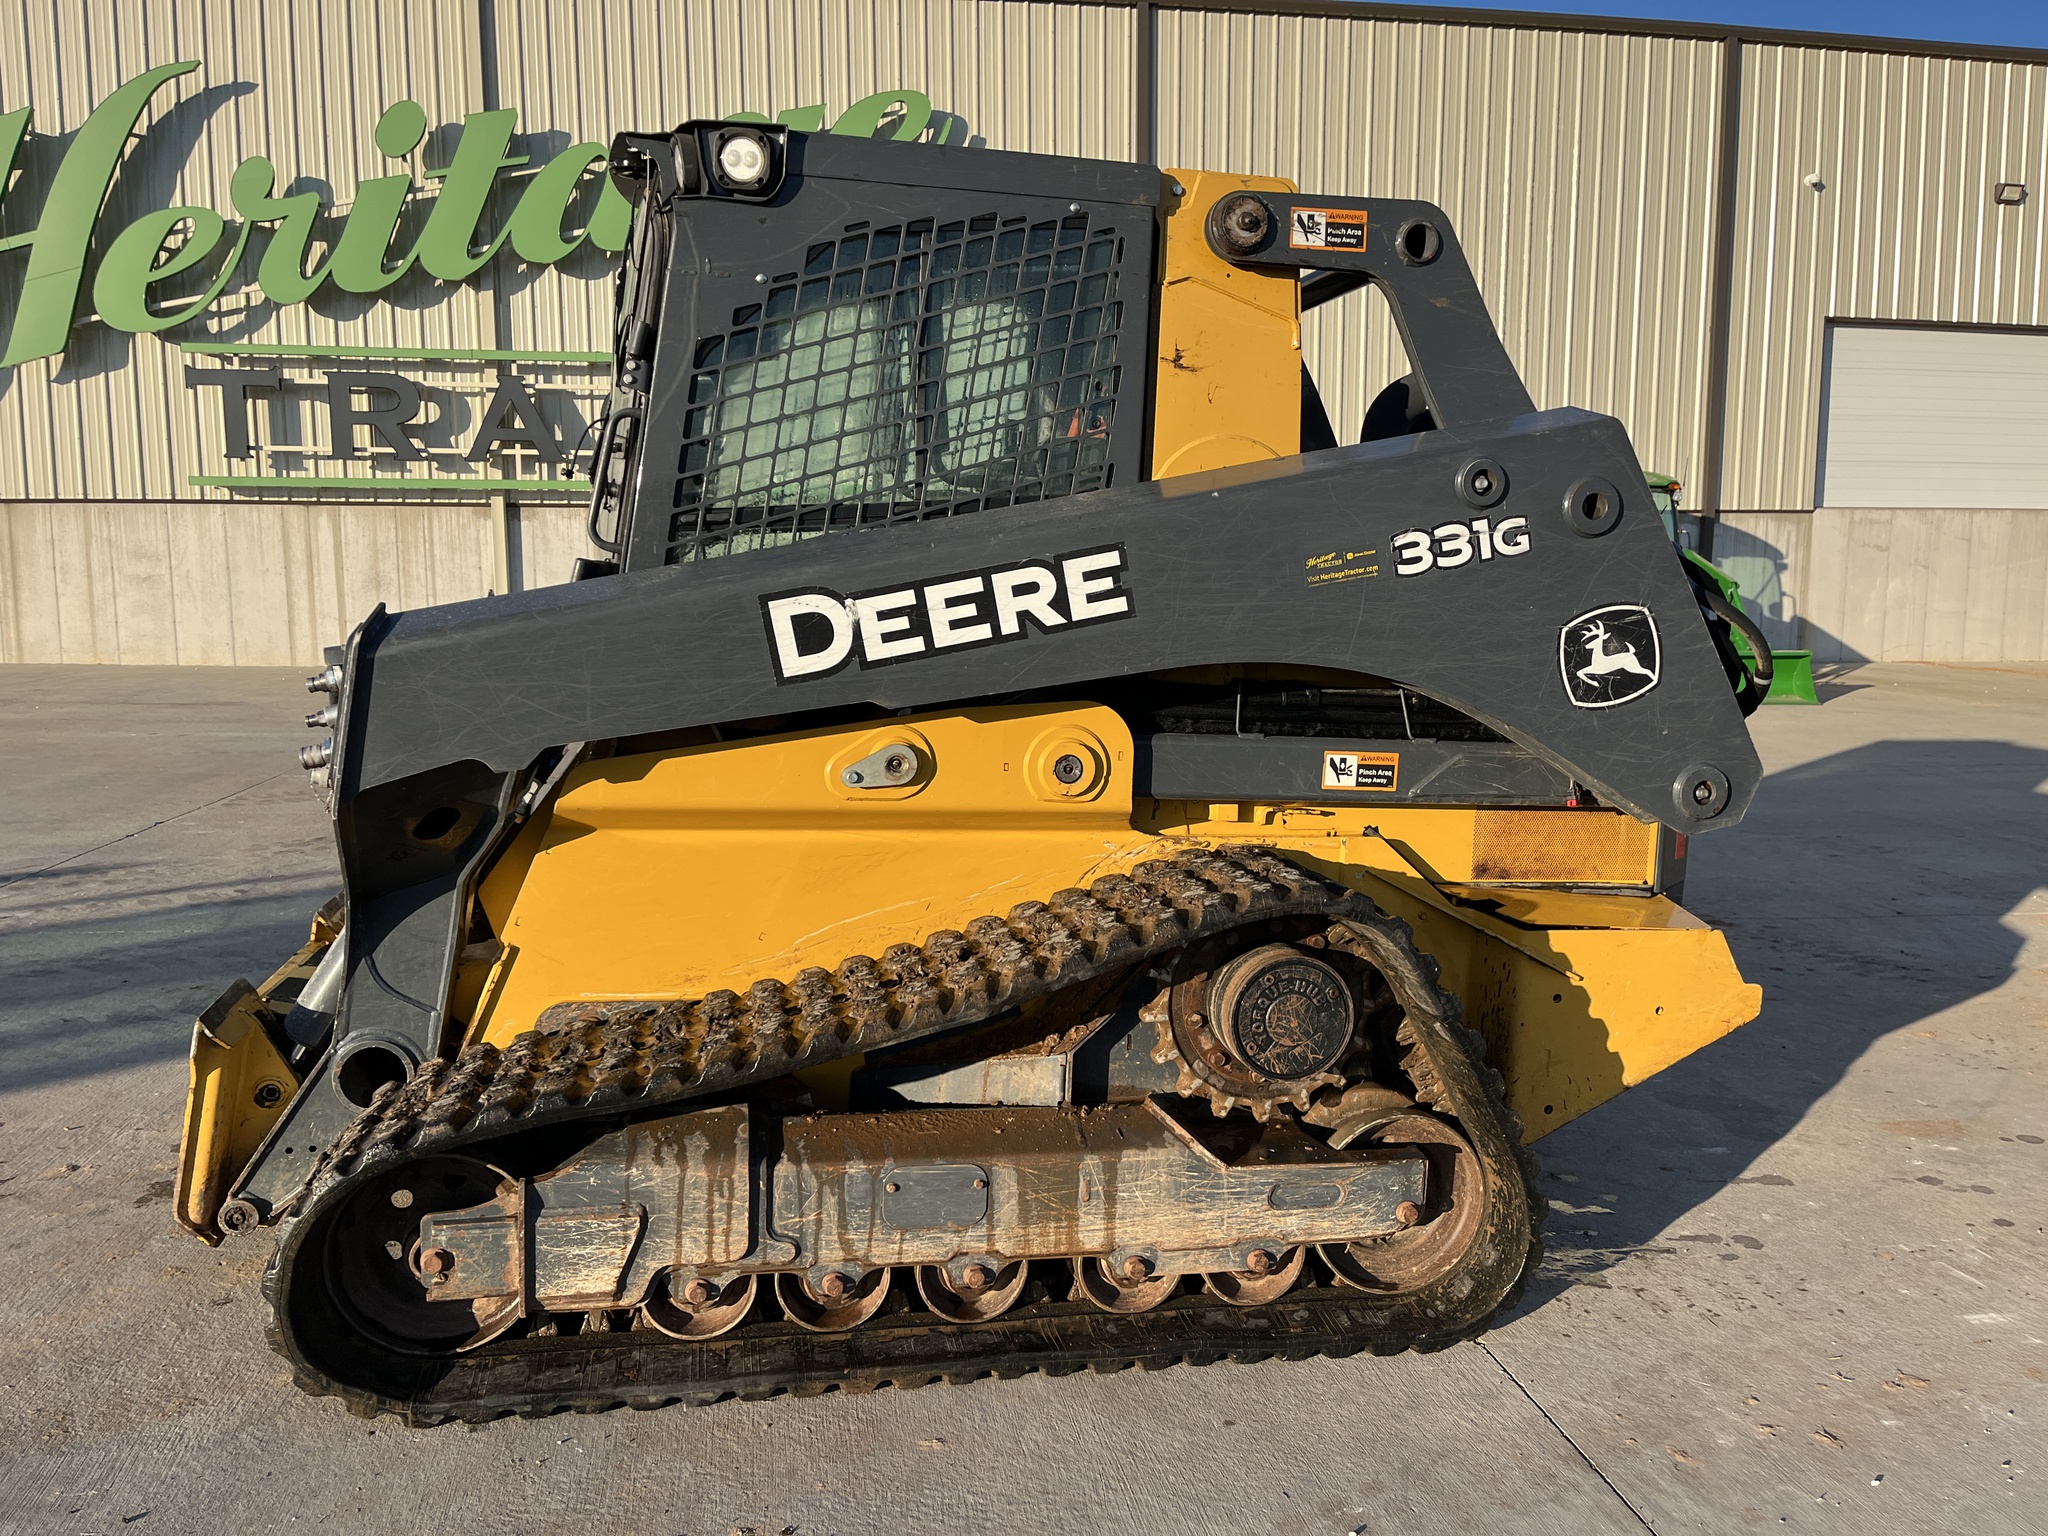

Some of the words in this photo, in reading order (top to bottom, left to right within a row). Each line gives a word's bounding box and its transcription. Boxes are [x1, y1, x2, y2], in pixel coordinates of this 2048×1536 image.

[1346, 228, 1362, 236] Area
[1327, 235, 1342, 243] Keep
[1341, 236, 1357, 245] Away
[1393, 517, 1531, 575] 331G
[1319, 564, 1379, 581] HeritageTractor.com
[766, 548, 1130, 678] DEERE
[1358, 768, 1377, 776] Pinch
[1372, 777, 1388, 785] Away
